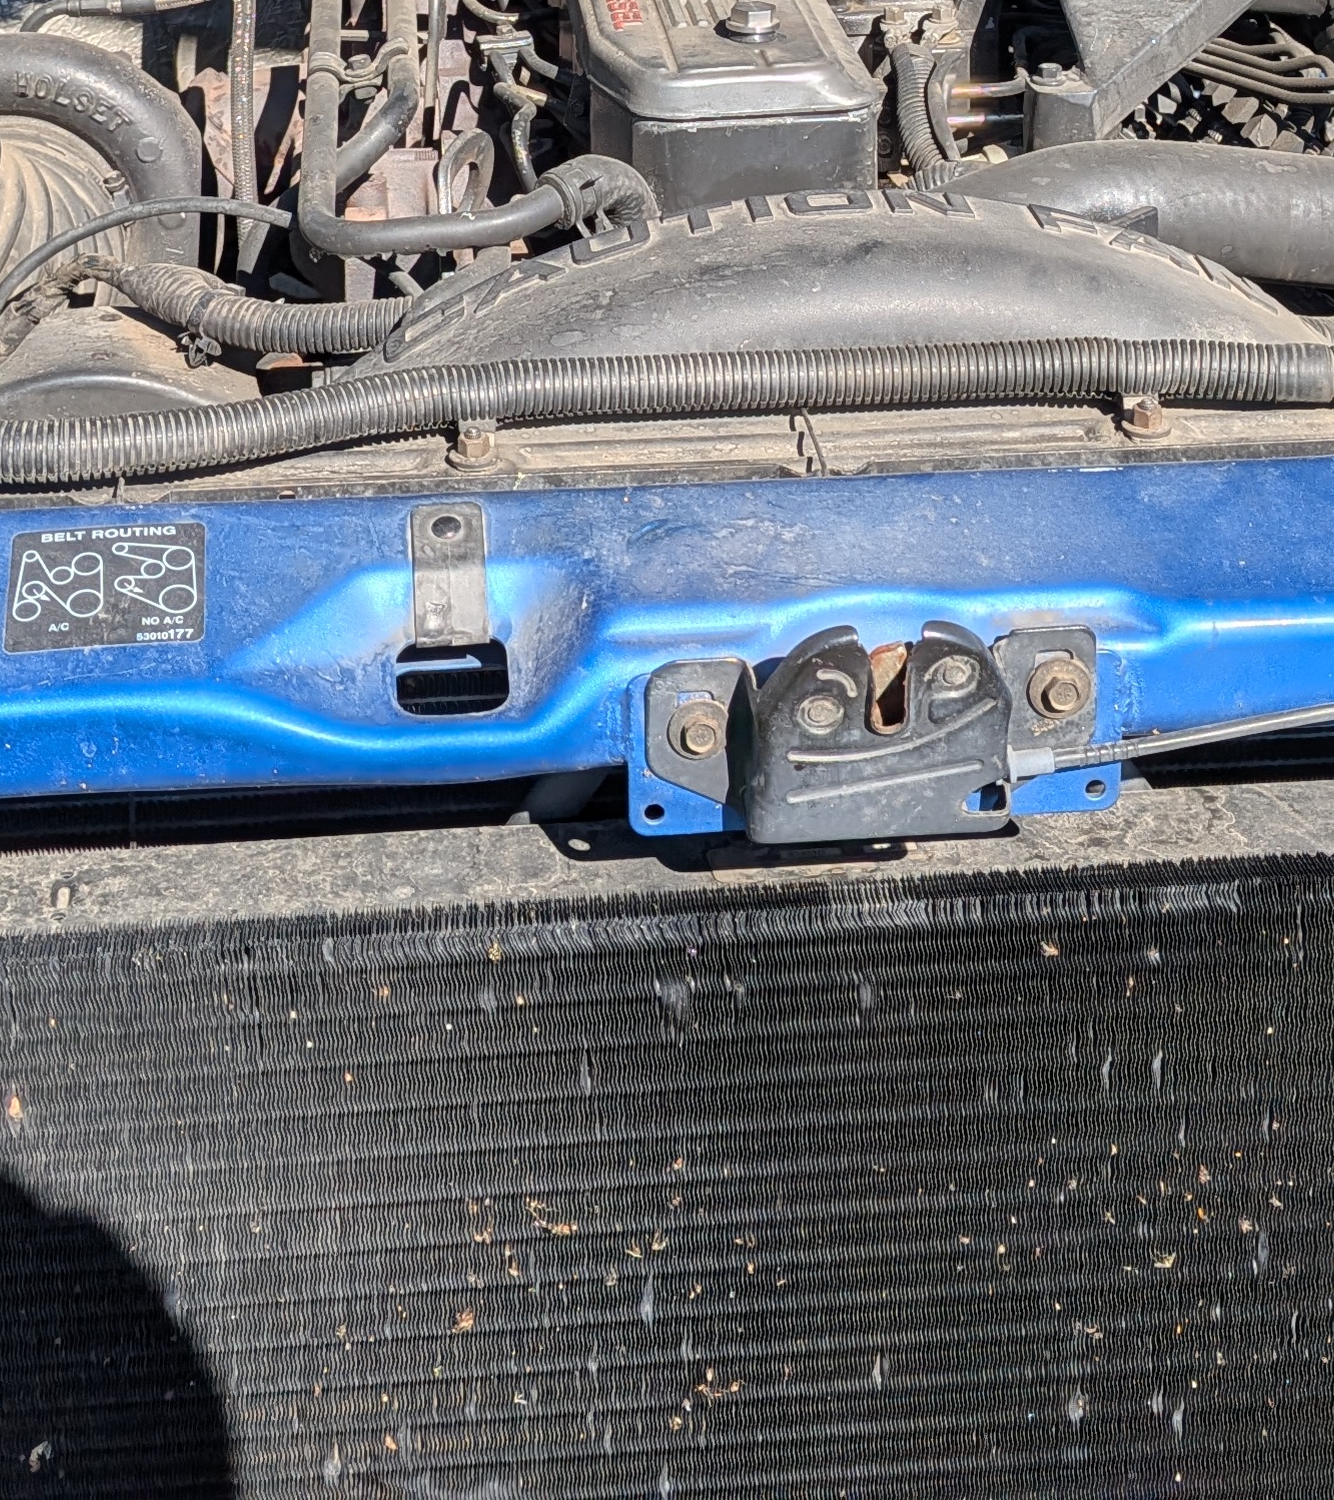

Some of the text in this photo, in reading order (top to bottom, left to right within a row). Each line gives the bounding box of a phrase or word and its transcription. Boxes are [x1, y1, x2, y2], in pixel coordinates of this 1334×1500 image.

[16, 70, 134, 133] HOLSET
[383, 188, 1282, 363] CAUTION FAN
[41, 526, 177, 543] BELT ROUTING
[48, 622, 70, 632] A/C
[141, 615, 184, 626] NO A/C
[136, 628, 194, 641] 53010177
